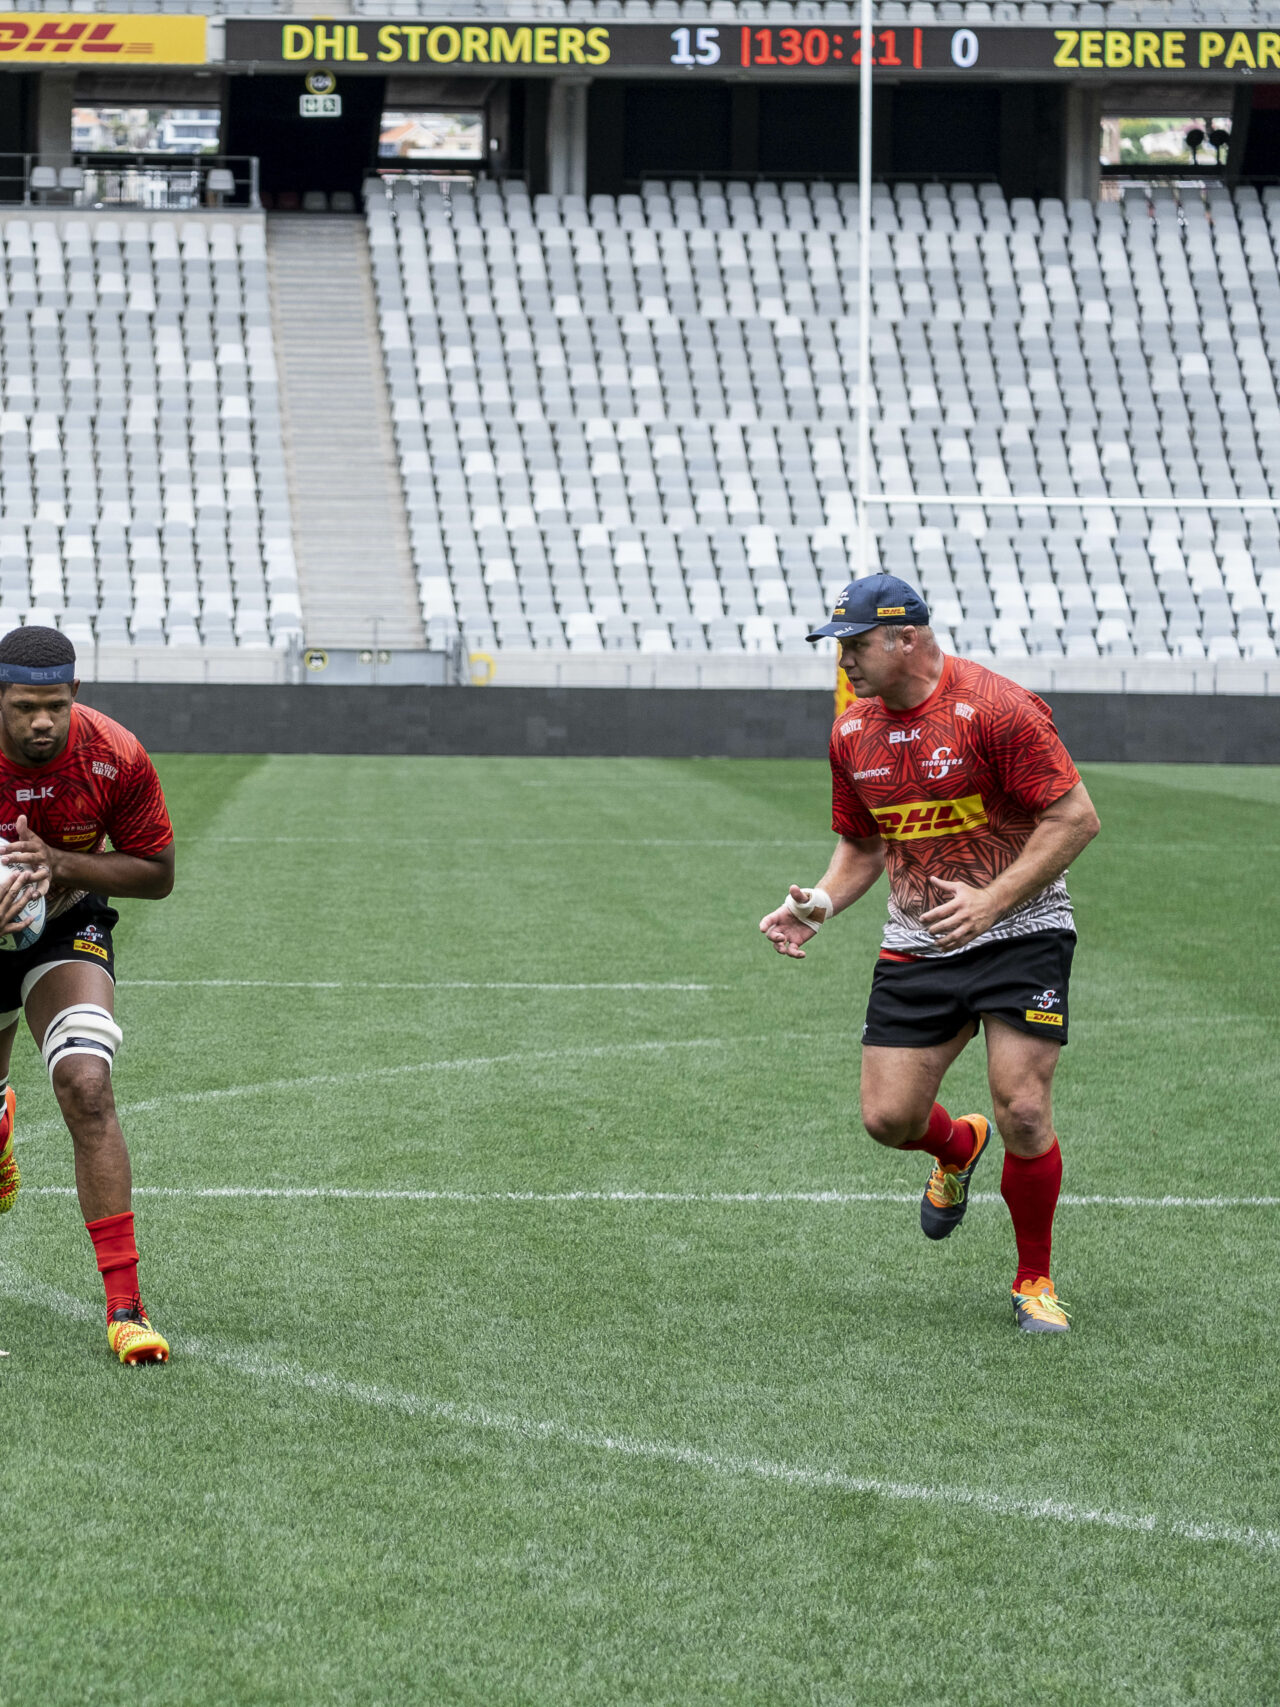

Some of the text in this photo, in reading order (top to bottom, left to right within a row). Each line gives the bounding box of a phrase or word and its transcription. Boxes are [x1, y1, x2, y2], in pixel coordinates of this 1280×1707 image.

[282, 24, 369, 61] DHL
[376, 25, 610, 64] STORMERS
[670, 27, 721, 65] 15
[950, 29, 979, 67] 0
[1054, 30, 1187, 68] ZEBRE
[30, 671, 62, 680] BLK
[889, 727, 921, 744] BLK
[921, 758, 963, 767] STORMERS
[16, 786, 55, 802] BLK
[875, 806, 965, 834] DHL
[1033, 1013, 1060, 1023] DHL
